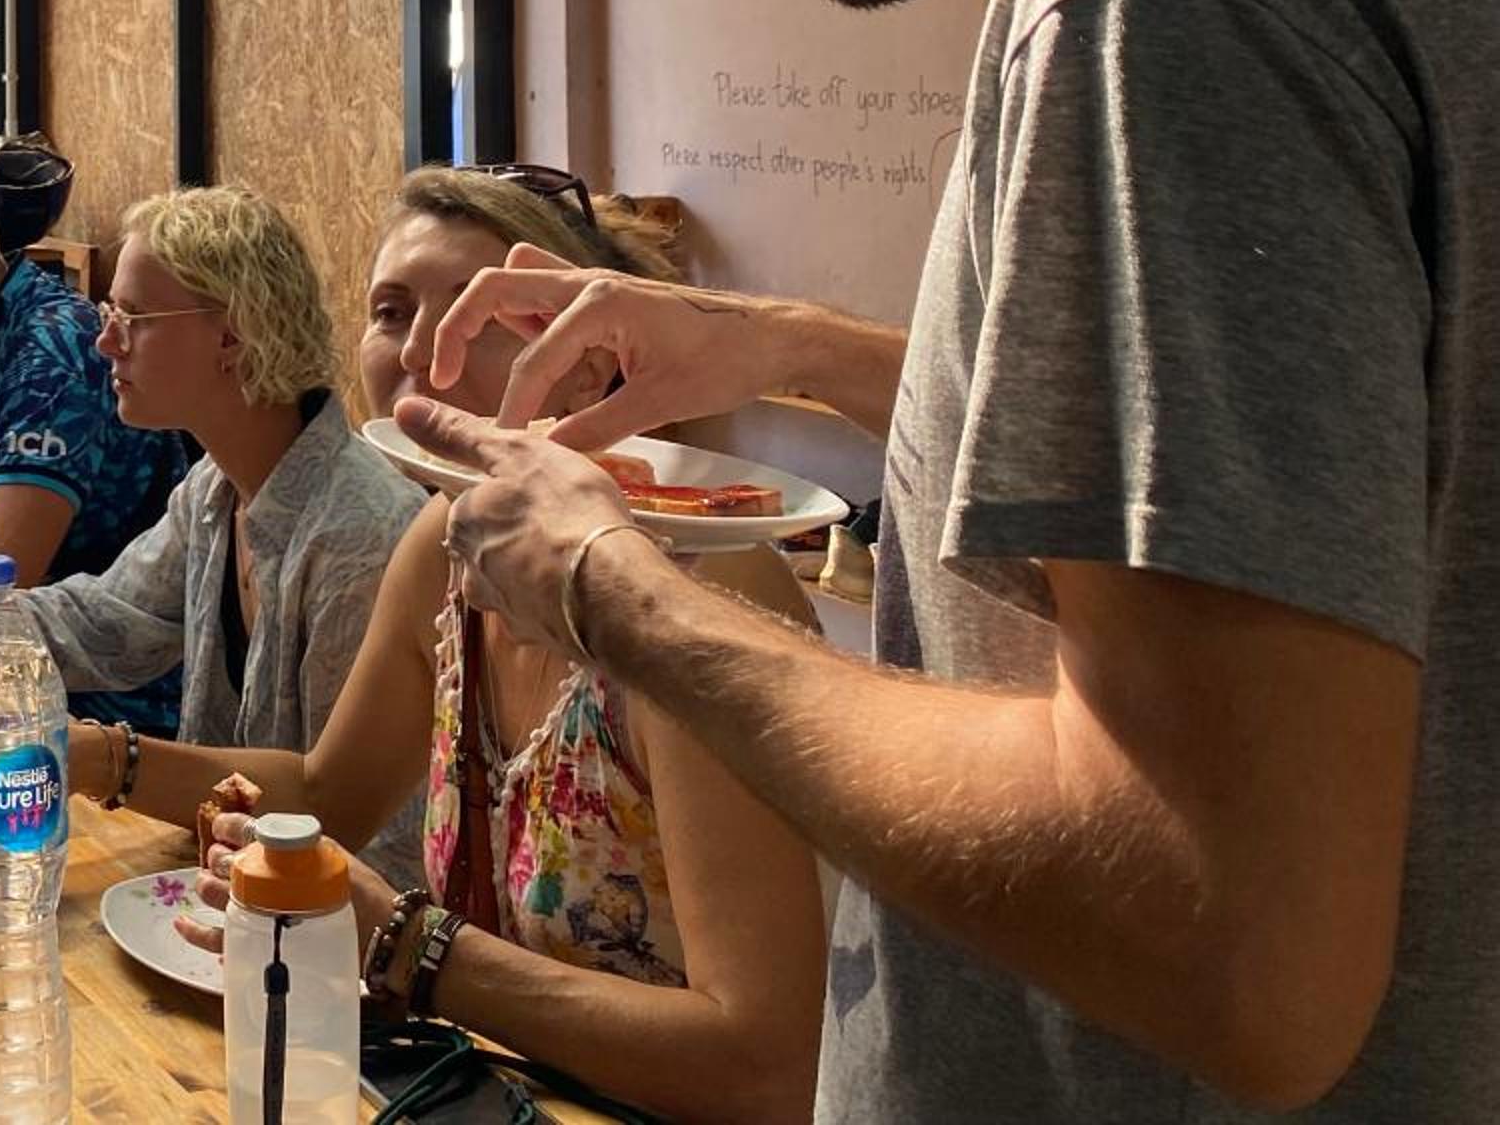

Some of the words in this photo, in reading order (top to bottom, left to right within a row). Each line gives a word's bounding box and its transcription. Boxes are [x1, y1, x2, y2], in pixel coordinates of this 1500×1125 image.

[714, 71, 766, 107] Please
[771, 61, 811, 108] take
[819, 74, 849, 108] off
[856, 91, 896, 130] your
[908, 73, 965, 116] shoes
[661, 141, 700, 167] Please
[708, 138, 765, 185] respect
[771, 145, 804, 174] other
[812, 149, 874, 197] people's
[35, 779, 59, 812] Life
